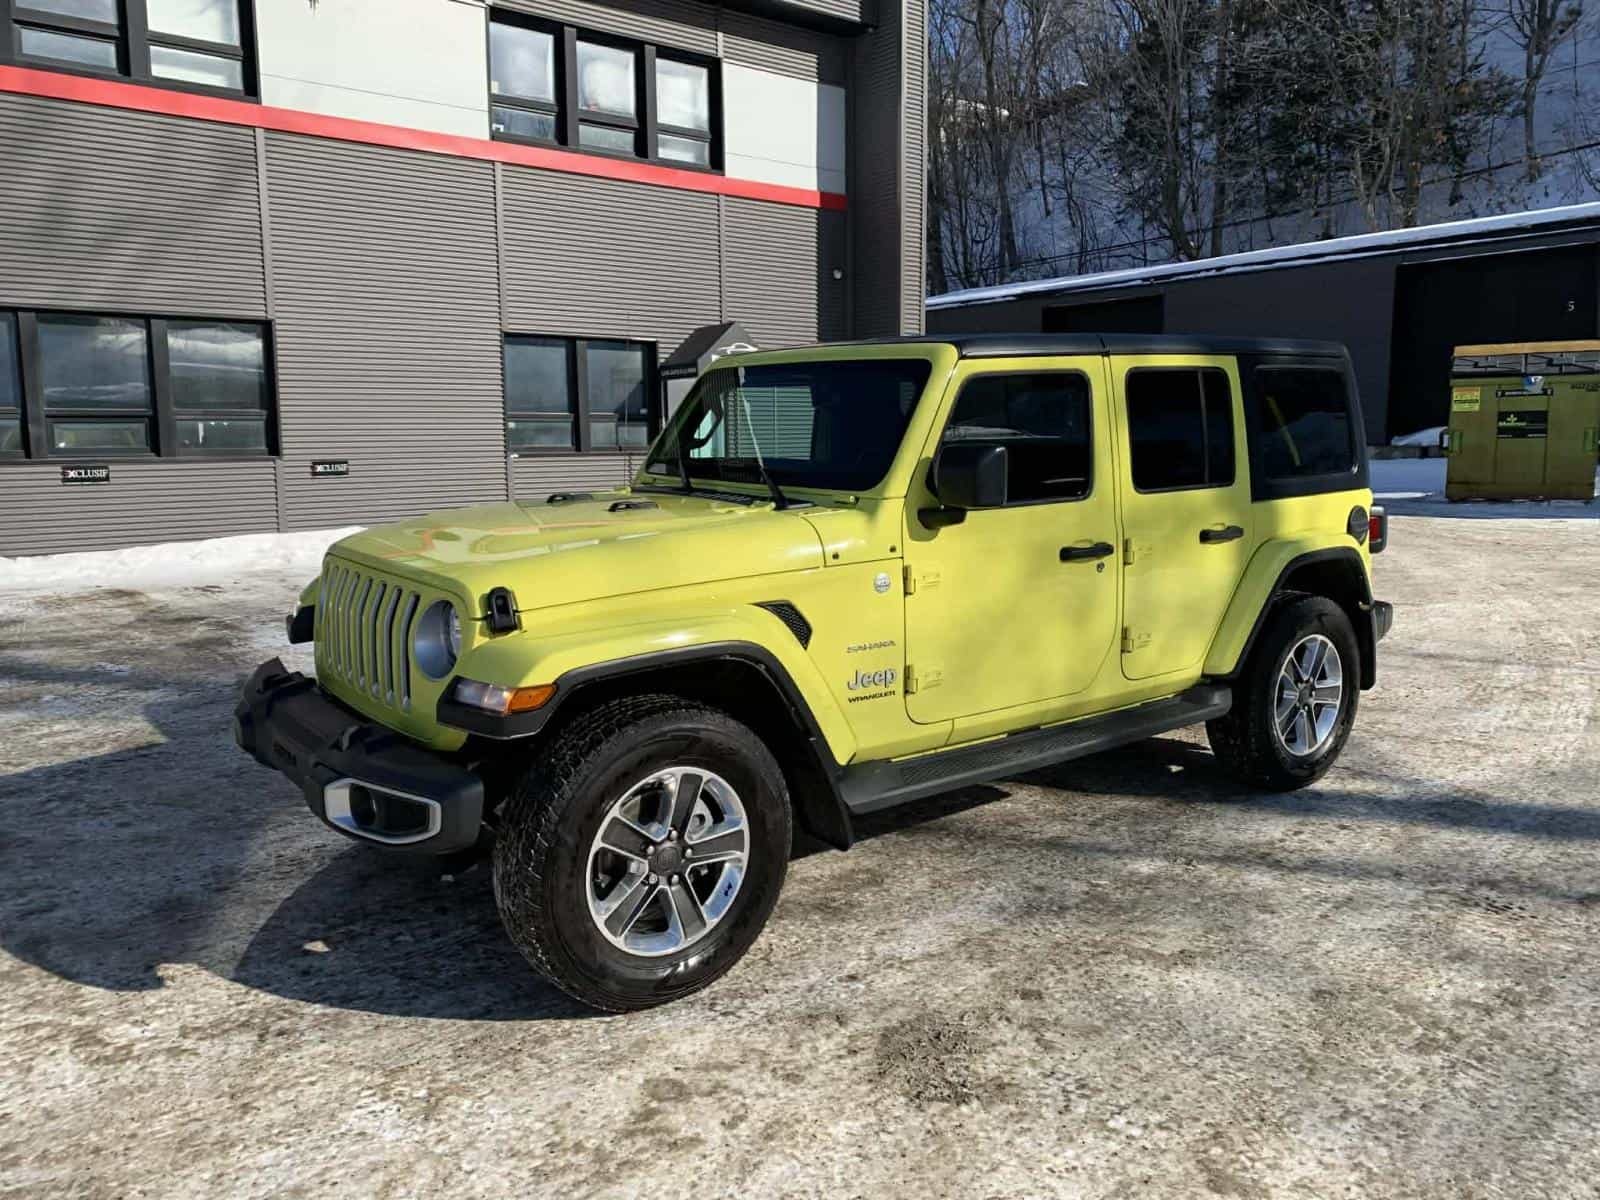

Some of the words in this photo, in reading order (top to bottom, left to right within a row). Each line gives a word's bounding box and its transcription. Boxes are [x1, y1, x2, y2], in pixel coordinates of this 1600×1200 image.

[1568, 300, 1575, 312] 5
[847, 668, 896, 690] Jeep
[847, 690, 896, 703] WRANGLER
